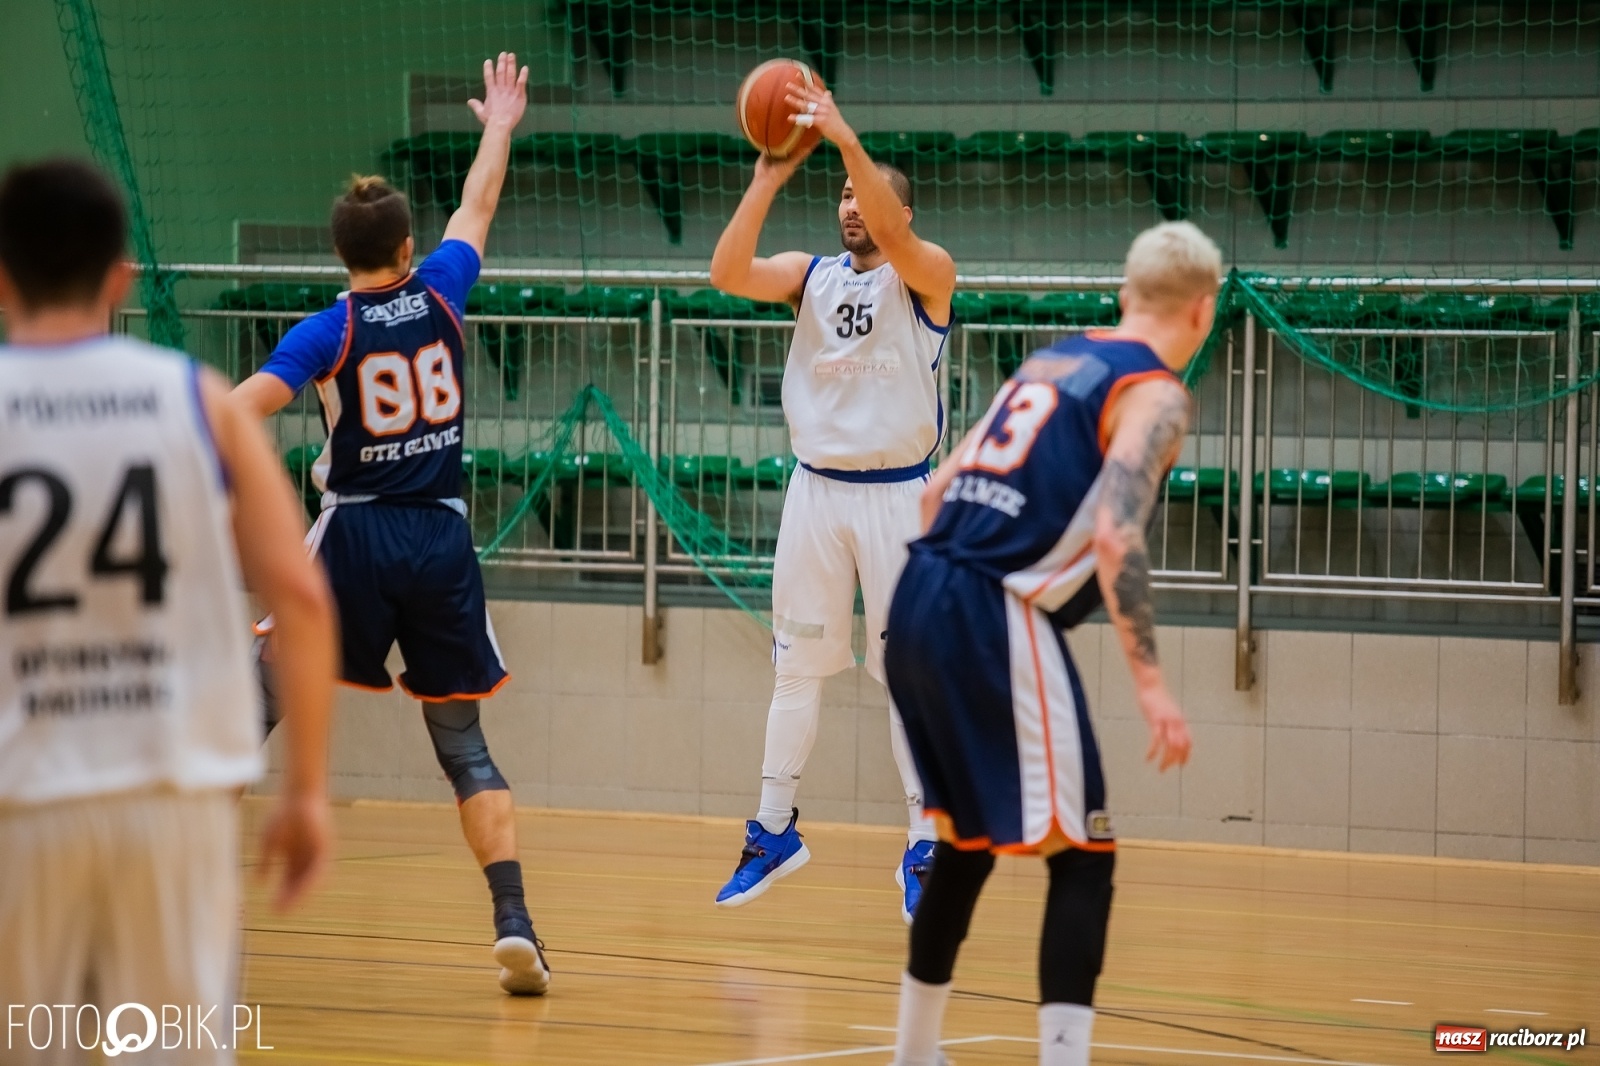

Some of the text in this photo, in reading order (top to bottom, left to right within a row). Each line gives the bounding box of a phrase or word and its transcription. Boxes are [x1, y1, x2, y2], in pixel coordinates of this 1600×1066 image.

[836, 303, 873, 339] 35
[360, 442, 401, 462] GTK
[959, 380, 1059, 475] 13
[0, 462, 168, 616] 24
